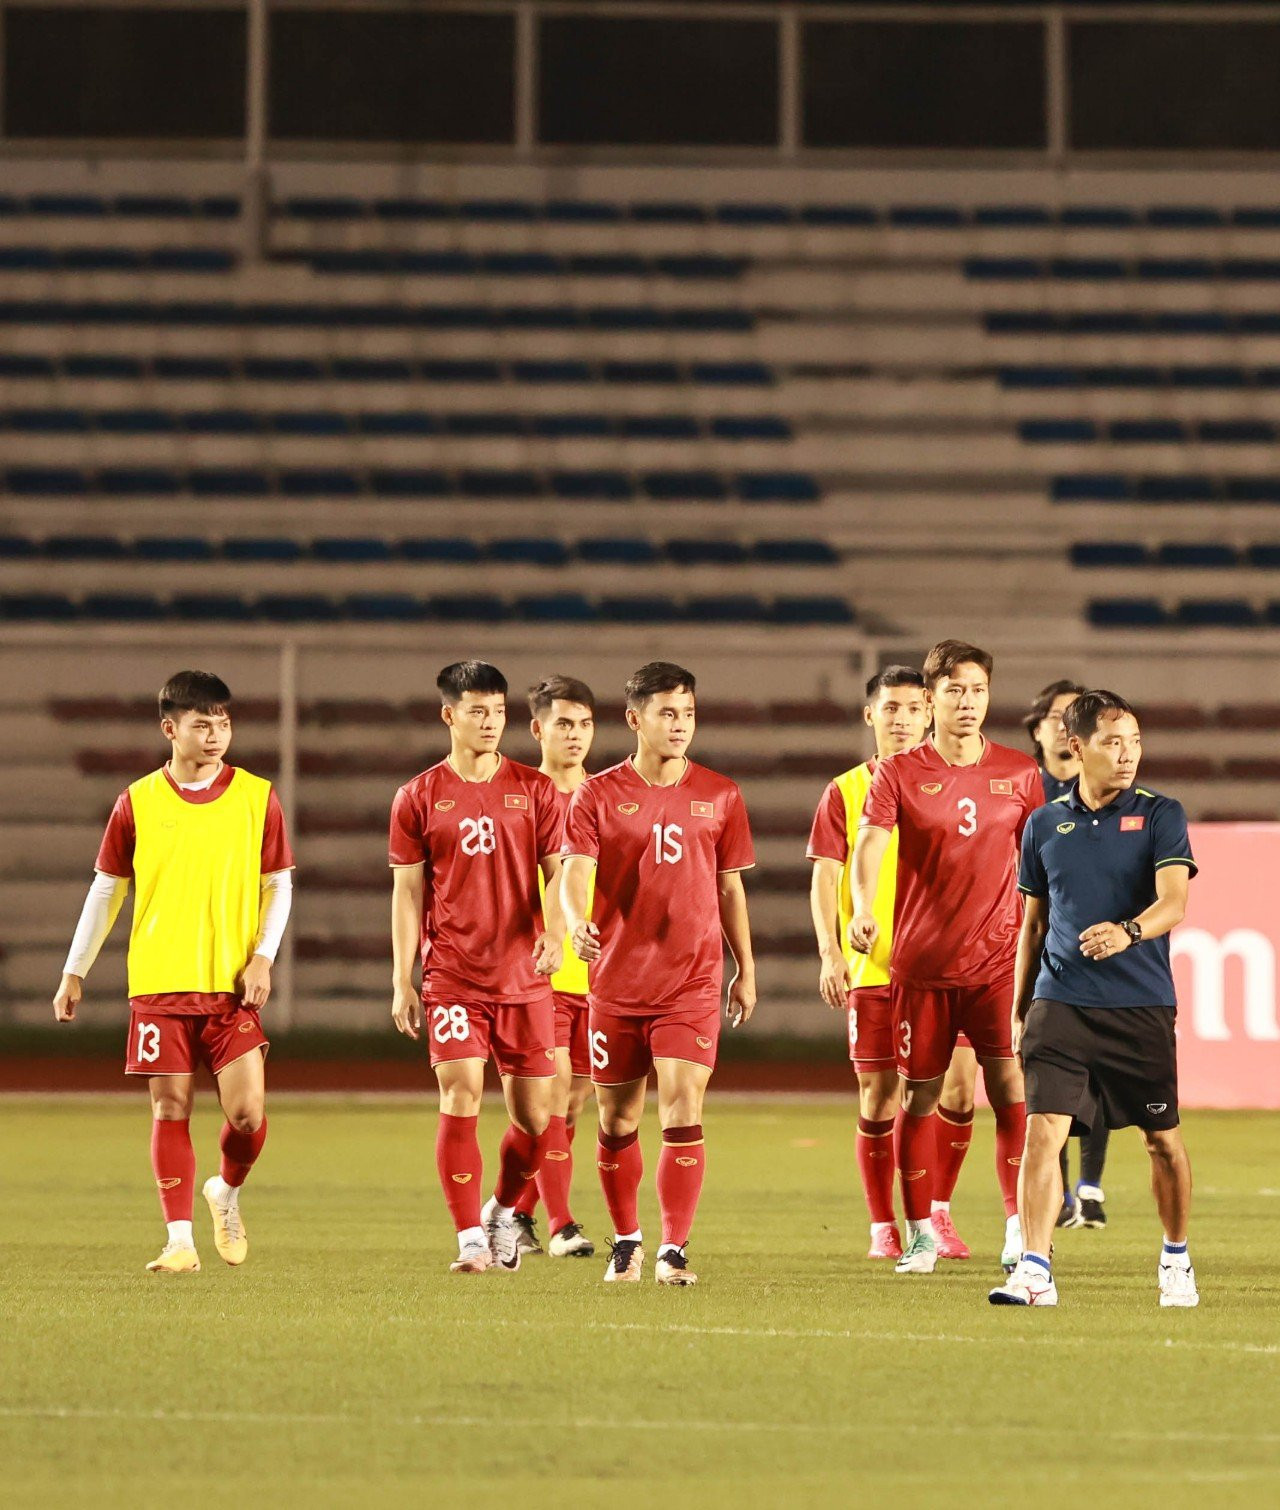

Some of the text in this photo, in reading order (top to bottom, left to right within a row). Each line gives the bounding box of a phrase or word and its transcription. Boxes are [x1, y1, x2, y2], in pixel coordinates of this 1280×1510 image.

[458, 815, 496, 856] 28
[957, 797, 978, 837] 3
[137, 1021, 161, 1063] 13
[432, 1004, 470, 1044] 28
[899, 1020, 912, 1059] 3
